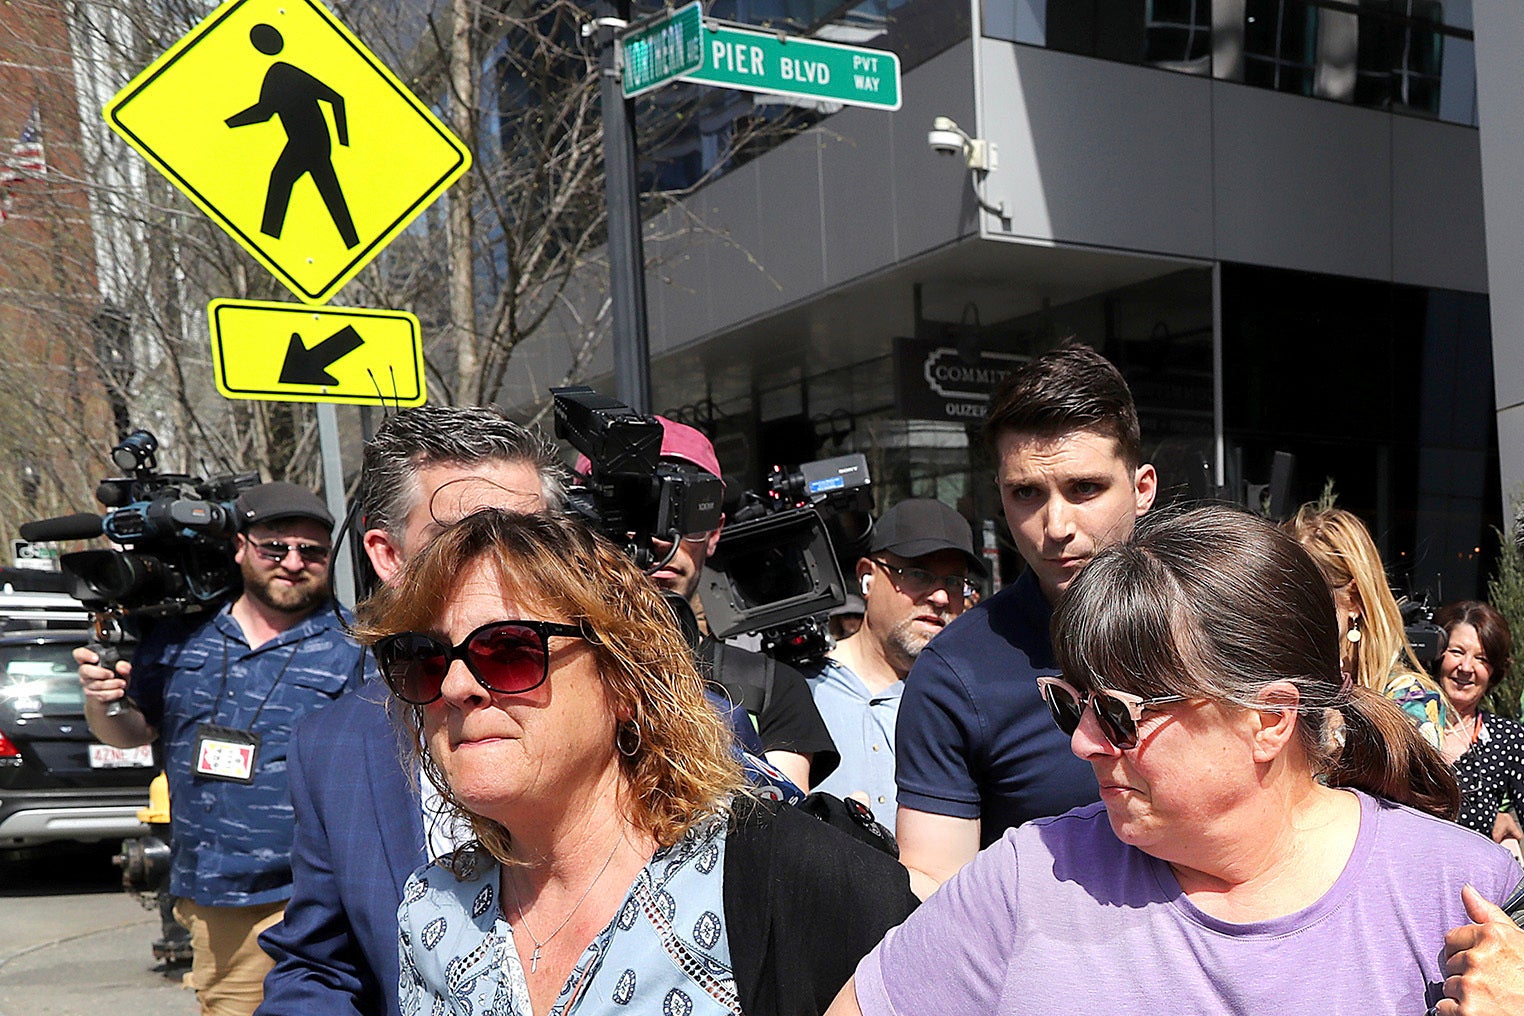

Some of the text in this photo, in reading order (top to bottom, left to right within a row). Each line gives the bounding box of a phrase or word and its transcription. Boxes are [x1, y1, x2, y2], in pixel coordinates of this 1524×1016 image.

[711, 41, 831, 85] PIER BLVD
[853, 55, 879, 73] PVT
[854, 74, 880, 92] WAY
[935, 365, 1012, 384] COMMIT
